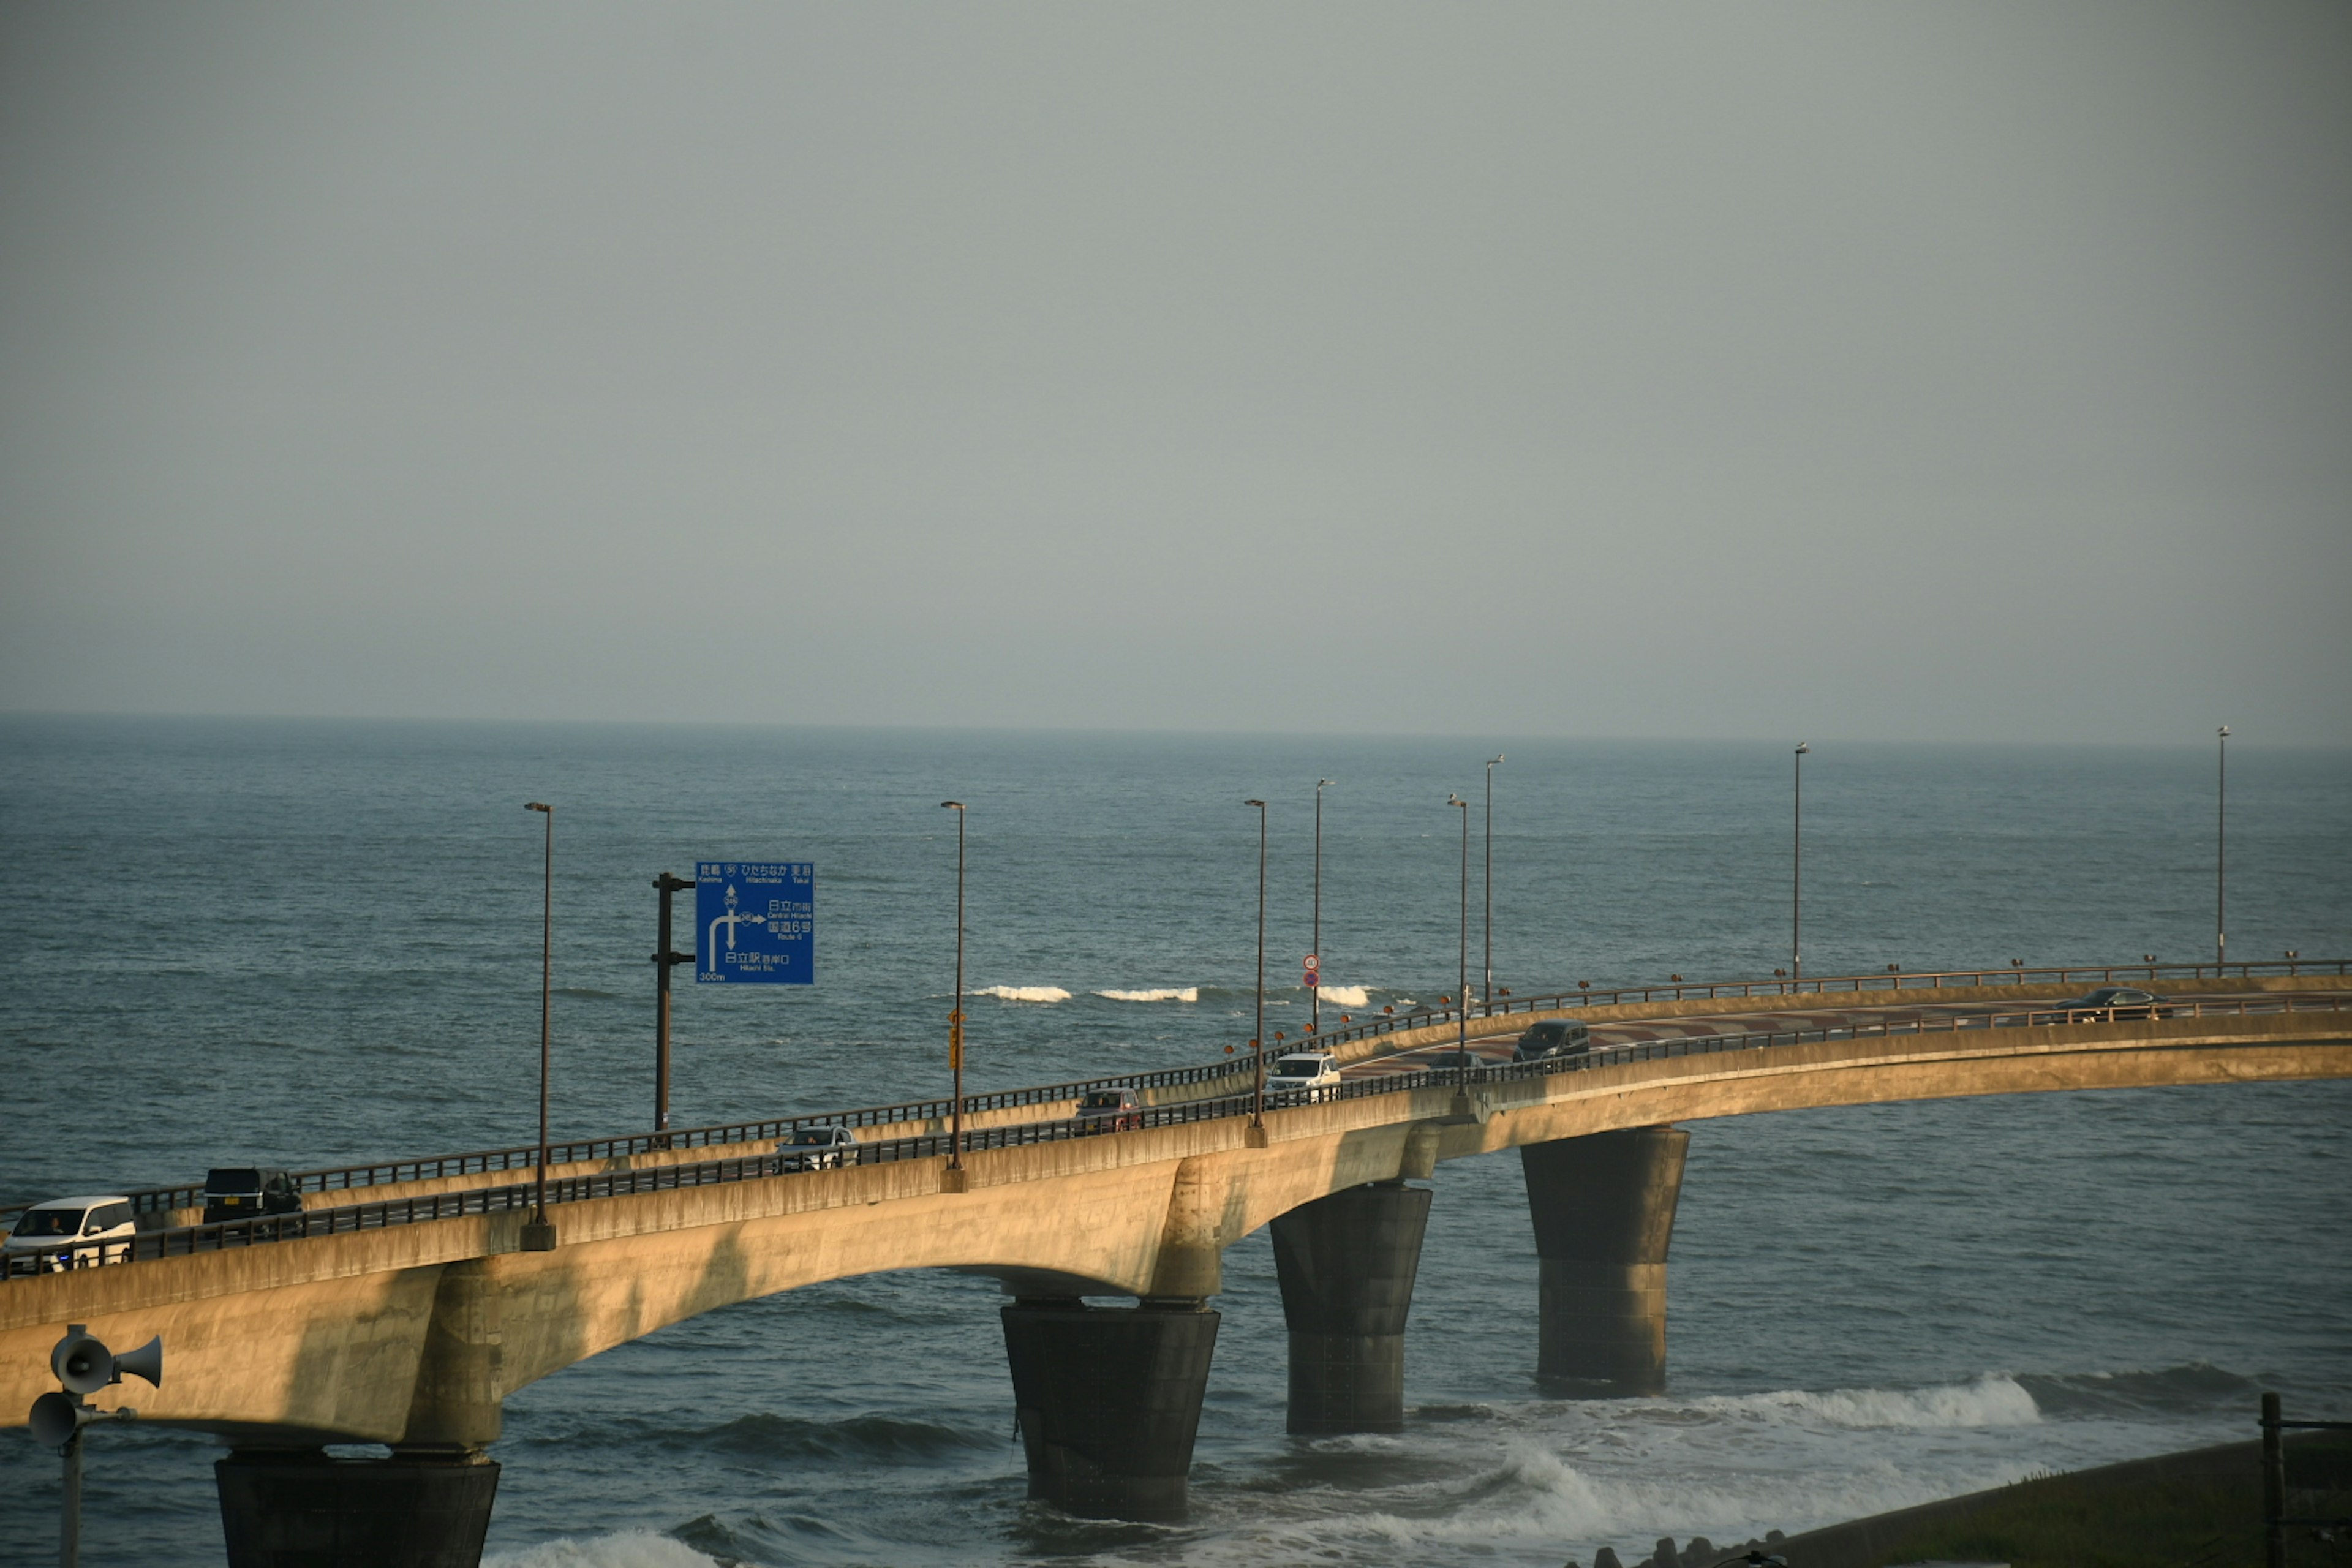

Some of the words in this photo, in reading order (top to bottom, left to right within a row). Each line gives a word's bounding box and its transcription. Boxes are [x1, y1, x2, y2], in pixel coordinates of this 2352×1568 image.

[741, 864, 787, 876] ひたちなか
[768, 920, 812, 933] 国道6号
[699, 972, 725, 981] 300m
